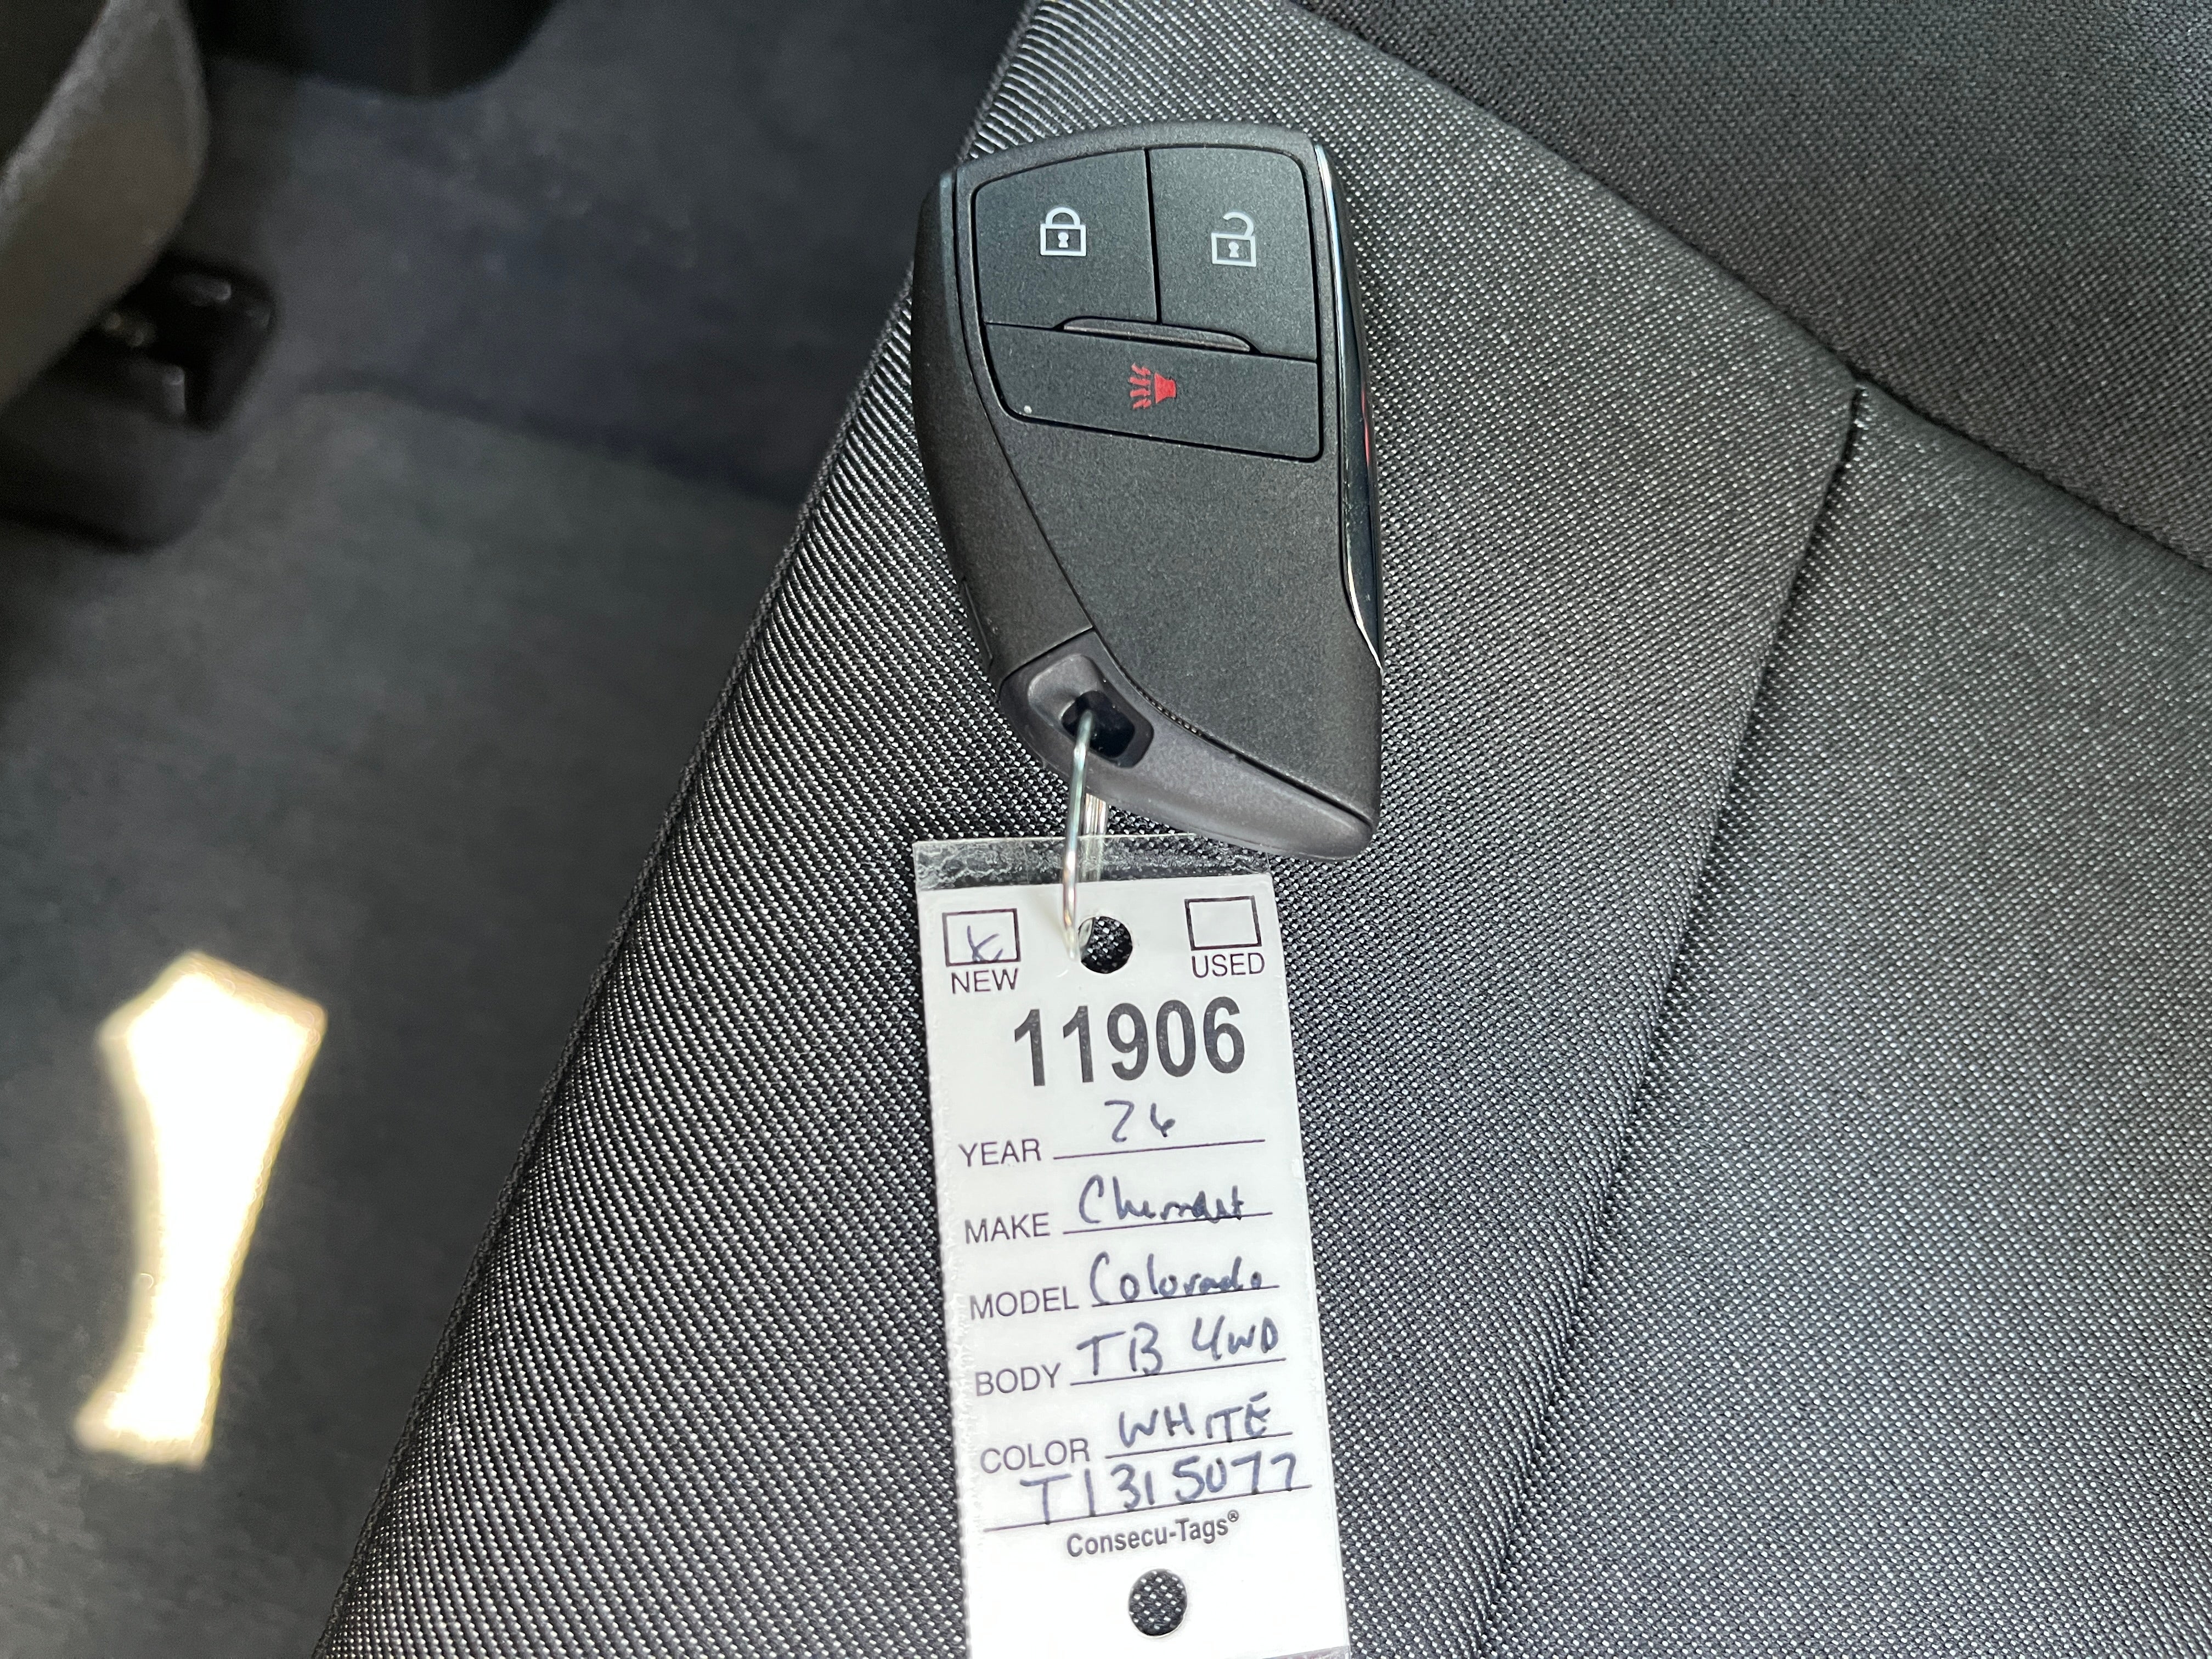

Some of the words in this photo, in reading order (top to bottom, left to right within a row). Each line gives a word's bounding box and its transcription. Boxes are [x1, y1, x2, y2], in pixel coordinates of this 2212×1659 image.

[951, 968, 1019, 994] NEW
[1191, 952, 1265, 978] USED
[1014, 996, 1245, 1087] 11906
[958, 1138, 1042, 1167] YEAR
[964, 1212, 1051, 1244] MAKE
[1089, 1251, 1263, 1305] Colorado
[969, 1285, 1079, 1320] MODEL
[975, 1363, 1062, 1397] BODY
[1119, 1391, 1272, 1448] WHITE
[980, 1438, 1090, 1474] COLOR
